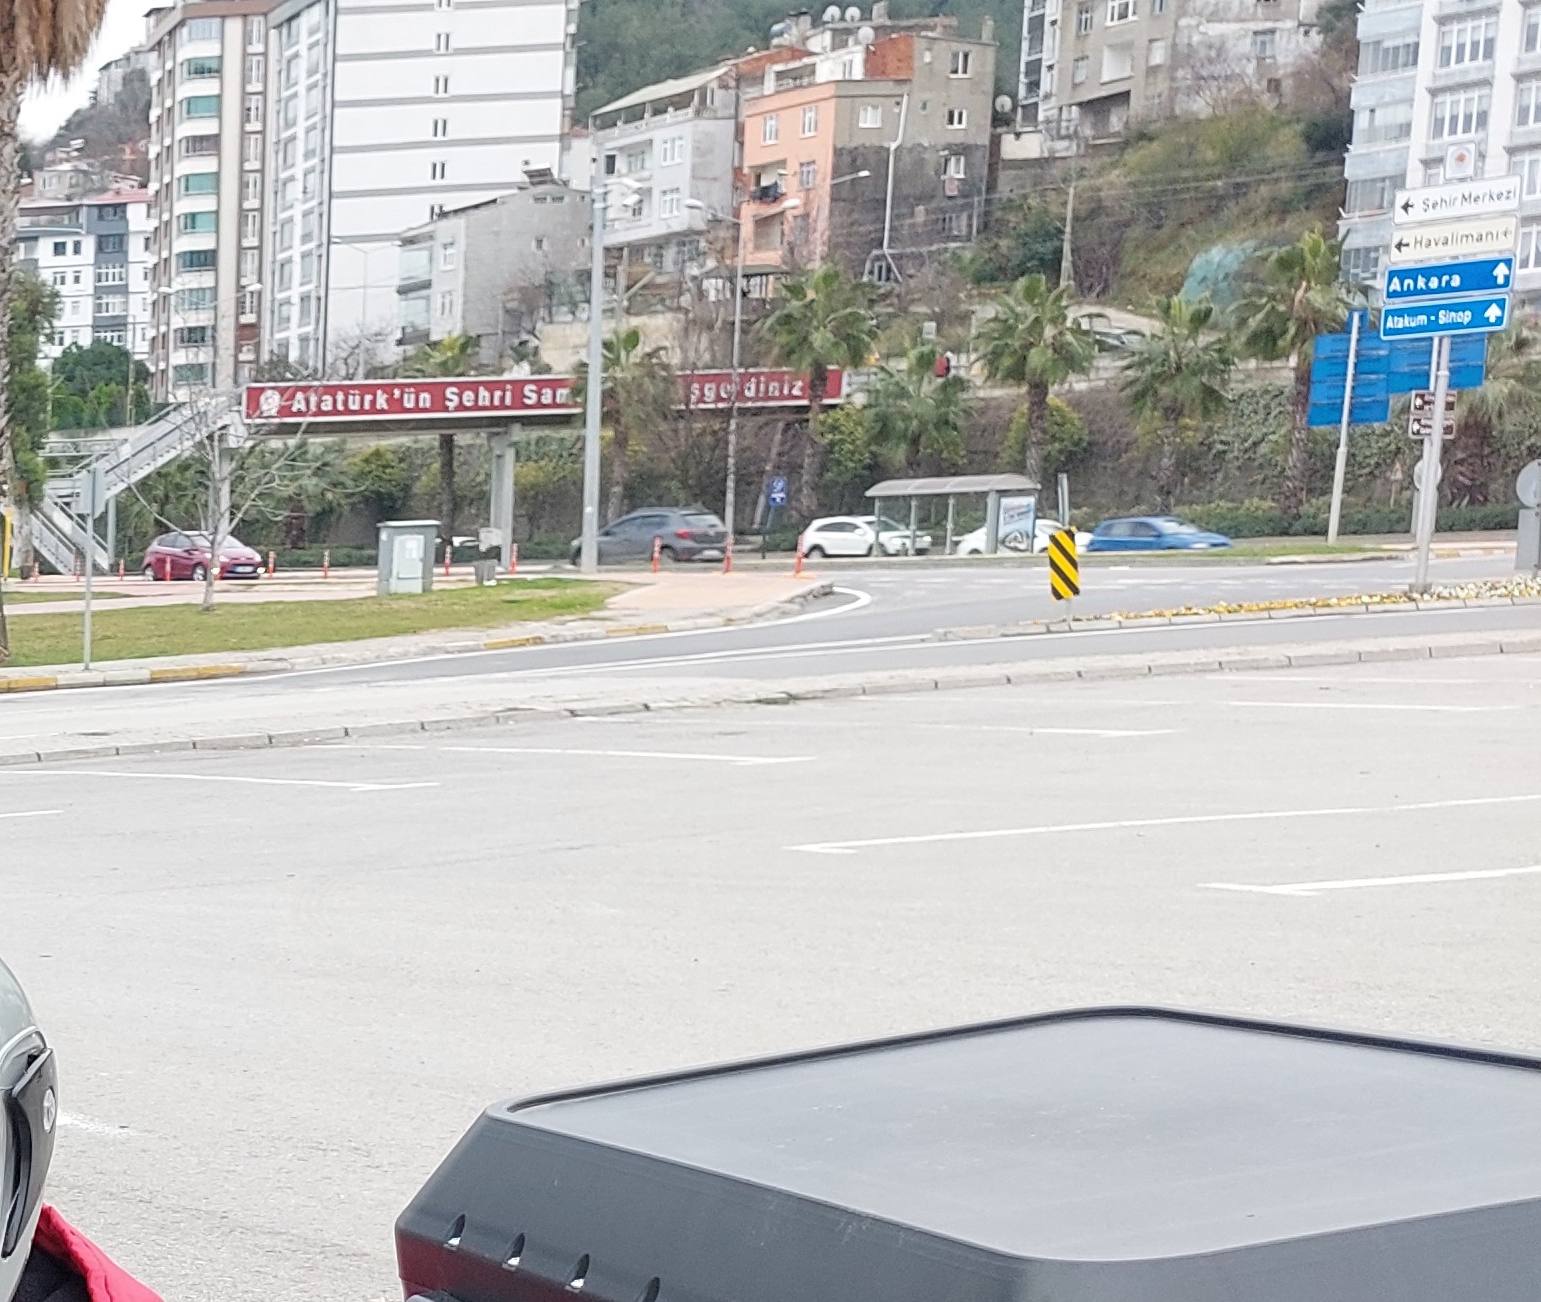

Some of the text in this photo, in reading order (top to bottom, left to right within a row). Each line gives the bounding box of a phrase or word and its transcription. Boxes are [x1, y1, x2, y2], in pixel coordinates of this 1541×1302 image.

[1422, 188, 1516, 213] Şehir Merkezi
[1388, 274, 1461, 293] Ankara
[1386, 314, 1428, 330] Atakum
[1438, 309, 1472, 326] Sinop
[444, 384, 513, 411] Şehri
